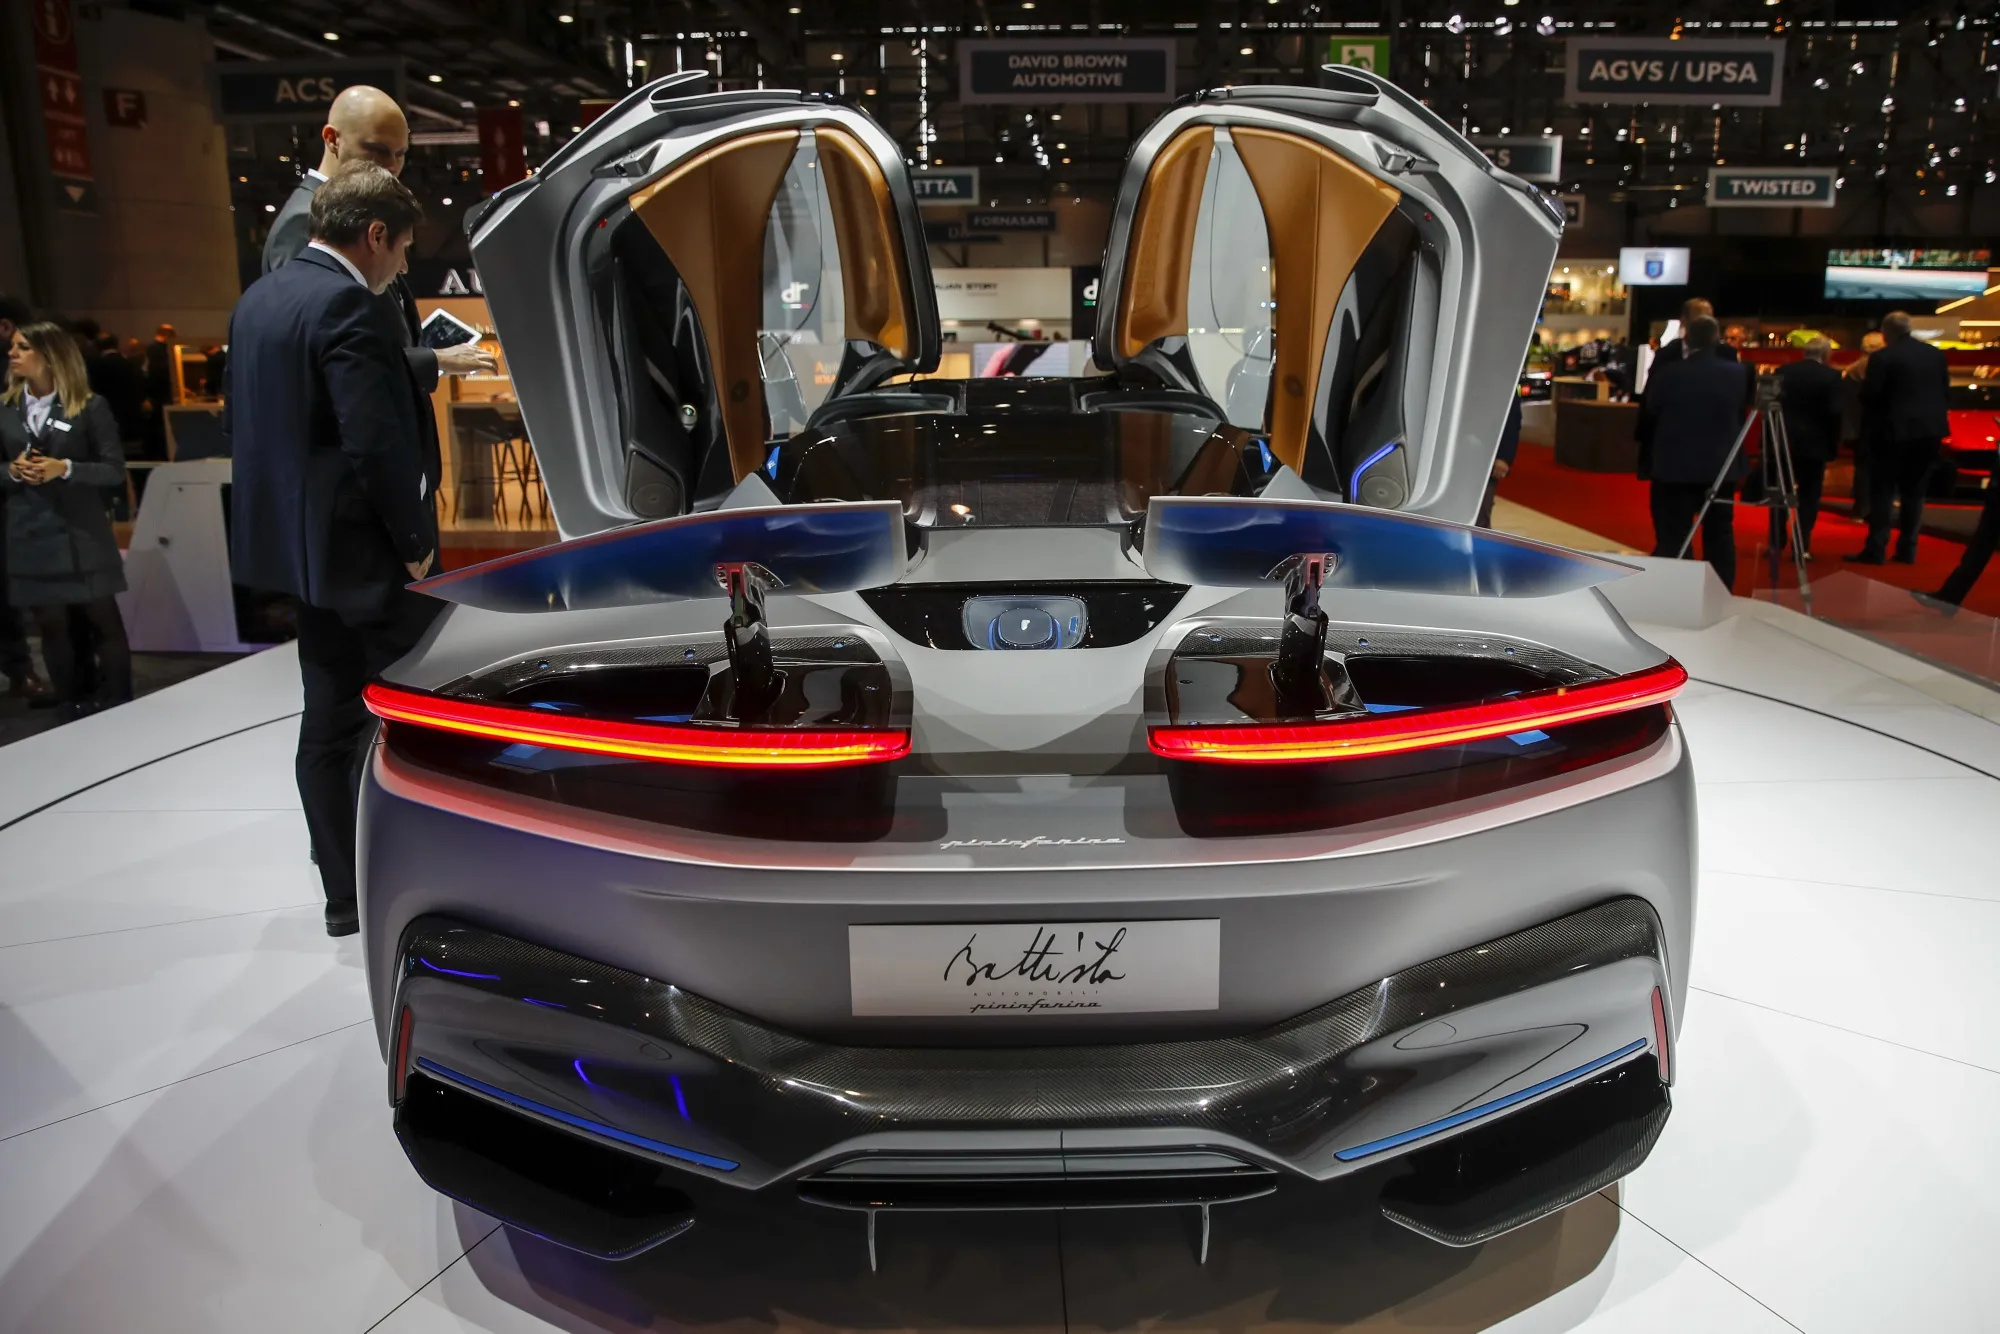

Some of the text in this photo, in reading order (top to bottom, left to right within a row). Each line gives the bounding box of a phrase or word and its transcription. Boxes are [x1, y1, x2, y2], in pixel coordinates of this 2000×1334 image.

[1009, 54, 1128, 69] DAVID BROWN
[1012, 72, 1124, 87] AUTOMOTIVE
[1588, 59, 1664, 82] AGVS
[1685, 61, 1759, 84] UPSA
[275, 78, 336, 103] ACS
[116, 91, 137, 119] F
[1728, 179, 1817, 196] TWISTED
[973, 214, 1049, 227] FORNASARI
[781, 281, 810, 303] dr
[940, 835, 1126, 850] pininfarina
[944, 926, 1127, 986] Battista
[970, 998, 1102, 1013] pininfarina
